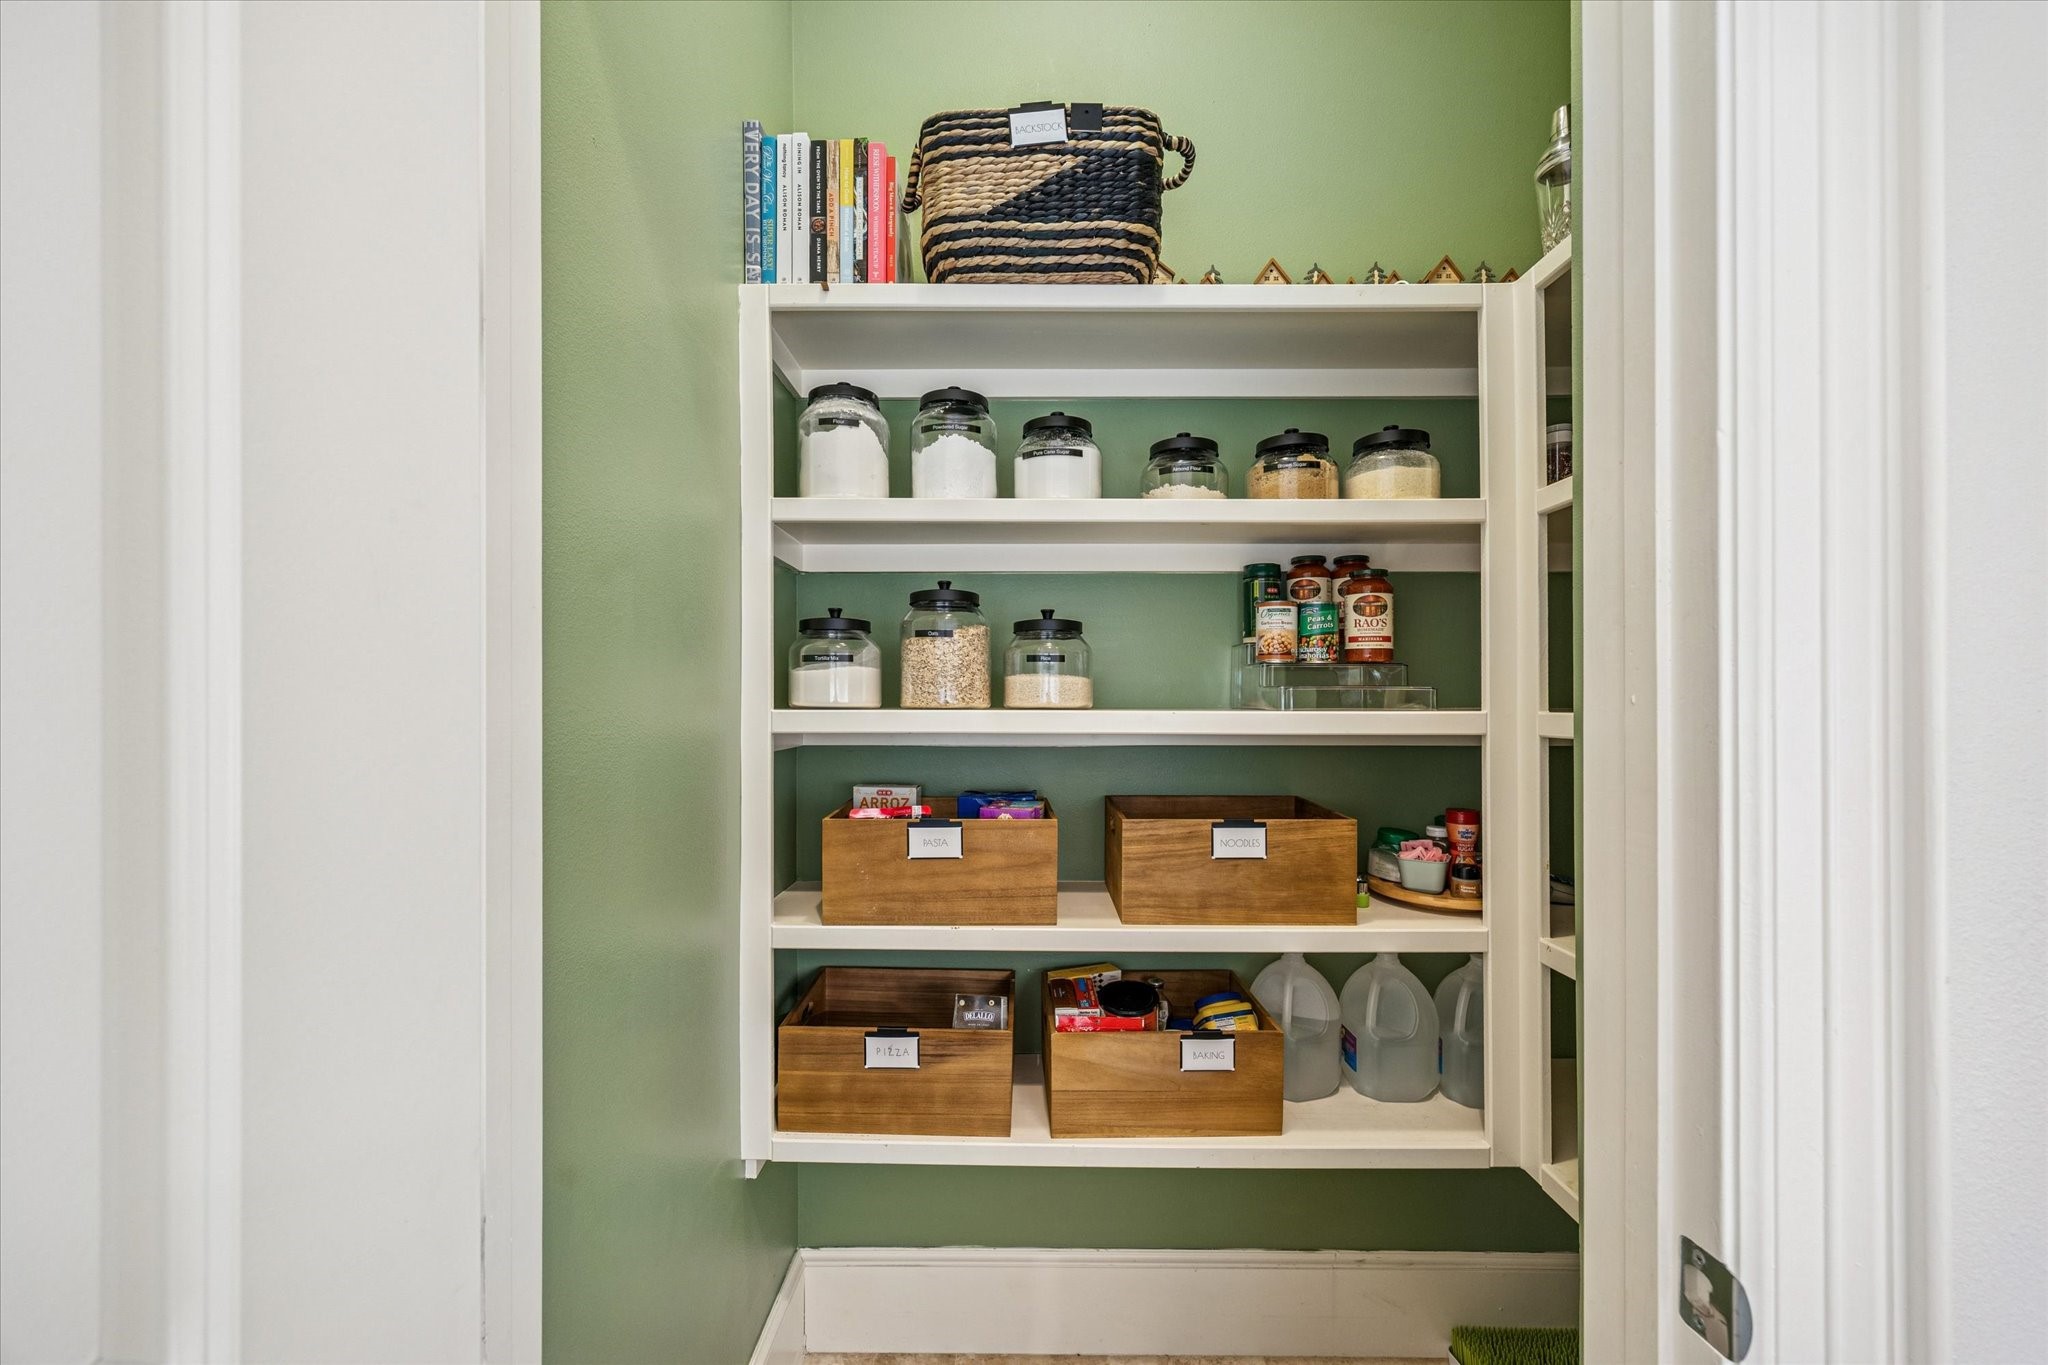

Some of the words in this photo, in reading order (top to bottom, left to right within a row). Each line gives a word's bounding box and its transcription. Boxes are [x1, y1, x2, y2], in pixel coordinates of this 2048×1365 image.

[1015, 122, 1063, 134] BACKSTOCK
[744, 120, 760, 176] EVERY
[745, 182, 760, 220] DAY
[746, 228, 760, 243] IS
[1354, 618, 1388, 628] RAO'S
[860, 797, 910, 808] ARROZ
[923, 838, 948, 848] PASTA
[1220, 838, 1261, 848] NOODLES
[876, 1046, 910, 1056] PIZZA
[1192, 1050, 1225, 1060] BAKING
